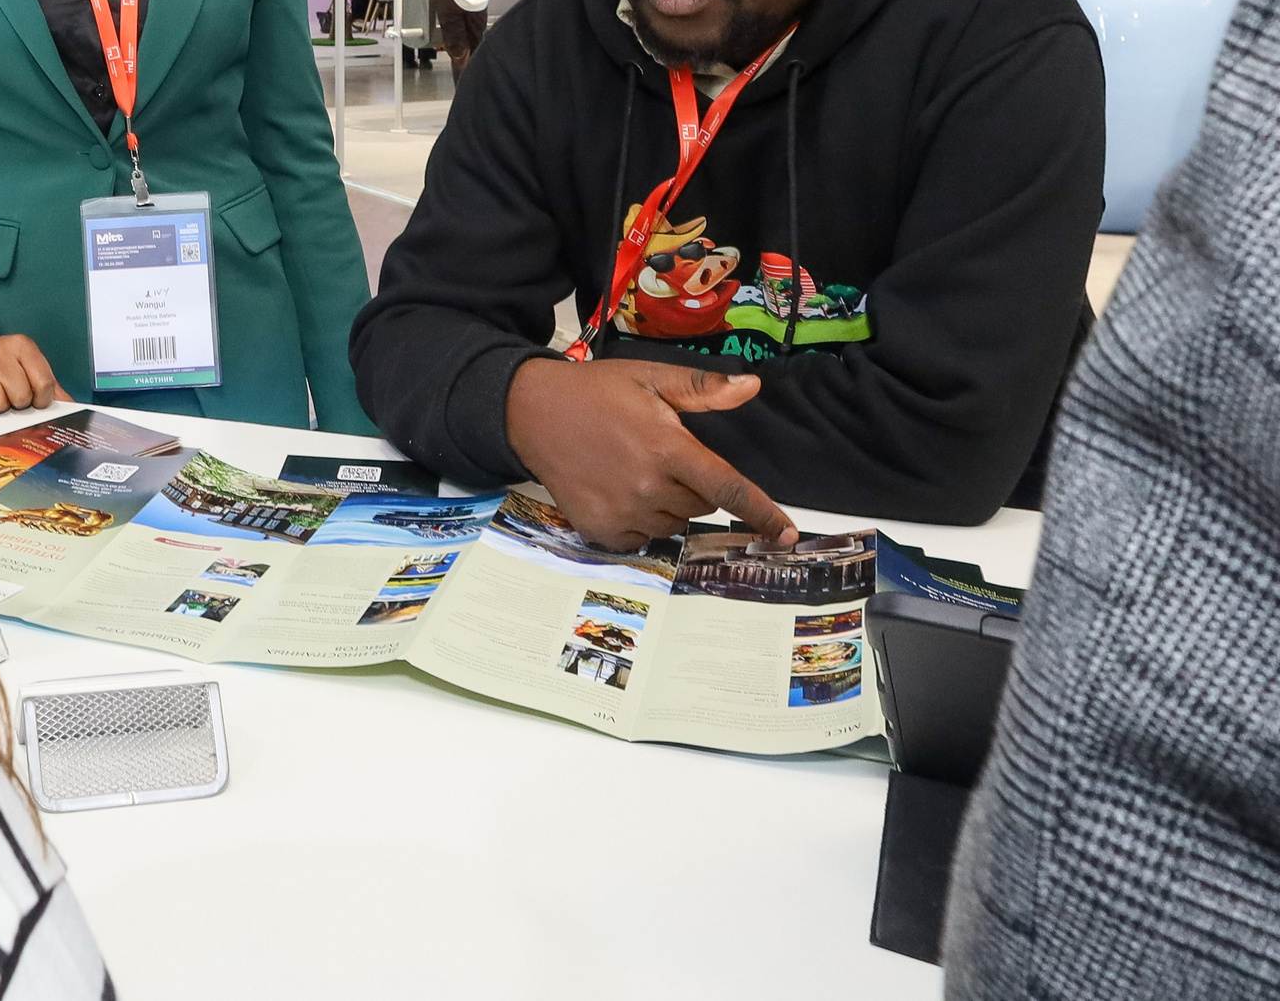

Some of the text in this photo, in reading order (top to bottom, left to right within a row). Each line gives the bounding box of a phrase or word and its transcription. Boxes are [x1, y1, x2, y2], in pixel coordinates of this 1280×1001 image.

[135, 301, 166, 309] Wangui
[134, 376, 174, 384] УЧАСТНИК
[45, 544, 67, 553] ПО
[131, 630, 201, 650] ШКОЛЬНЫЕ
[593, 712, 615, 723] VIP
[824, 722, 862, 738] MICE
